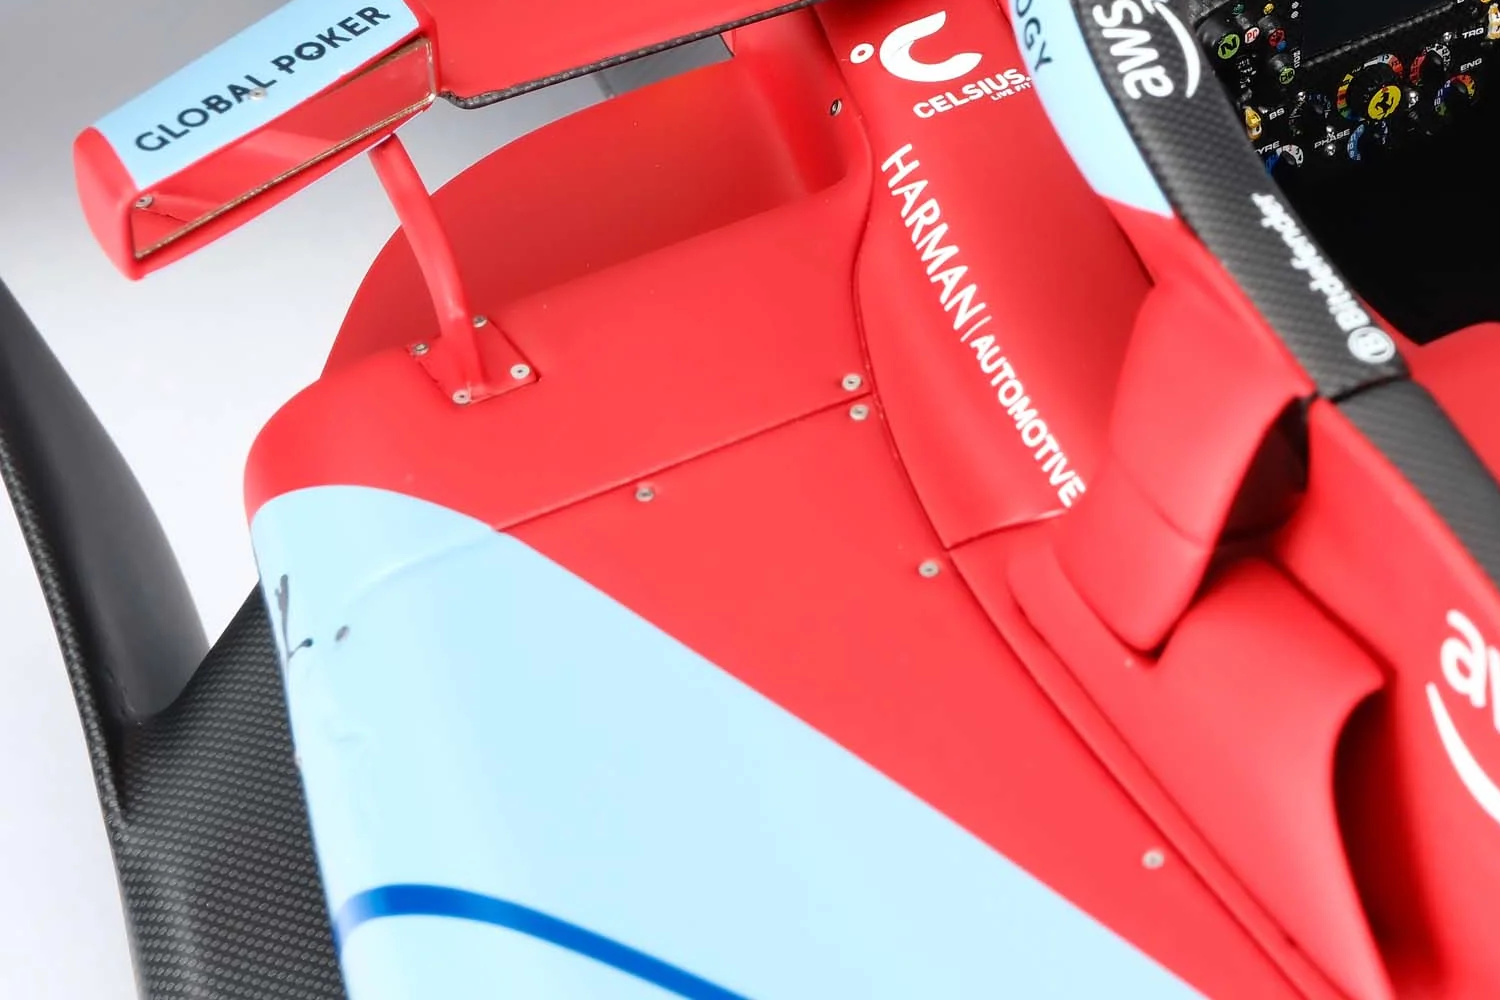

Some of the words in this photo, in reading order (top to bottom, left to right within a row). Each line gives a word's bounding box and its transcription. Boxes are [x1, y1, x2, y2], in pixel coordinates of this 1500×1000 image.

[134, 74, 278, 152] GLOBAL
[271, 6, 391, 74] POKER
[990, 89, 1015, 102] LIVE
[970, 335, 1086, 507] AUTOMOTIVE
